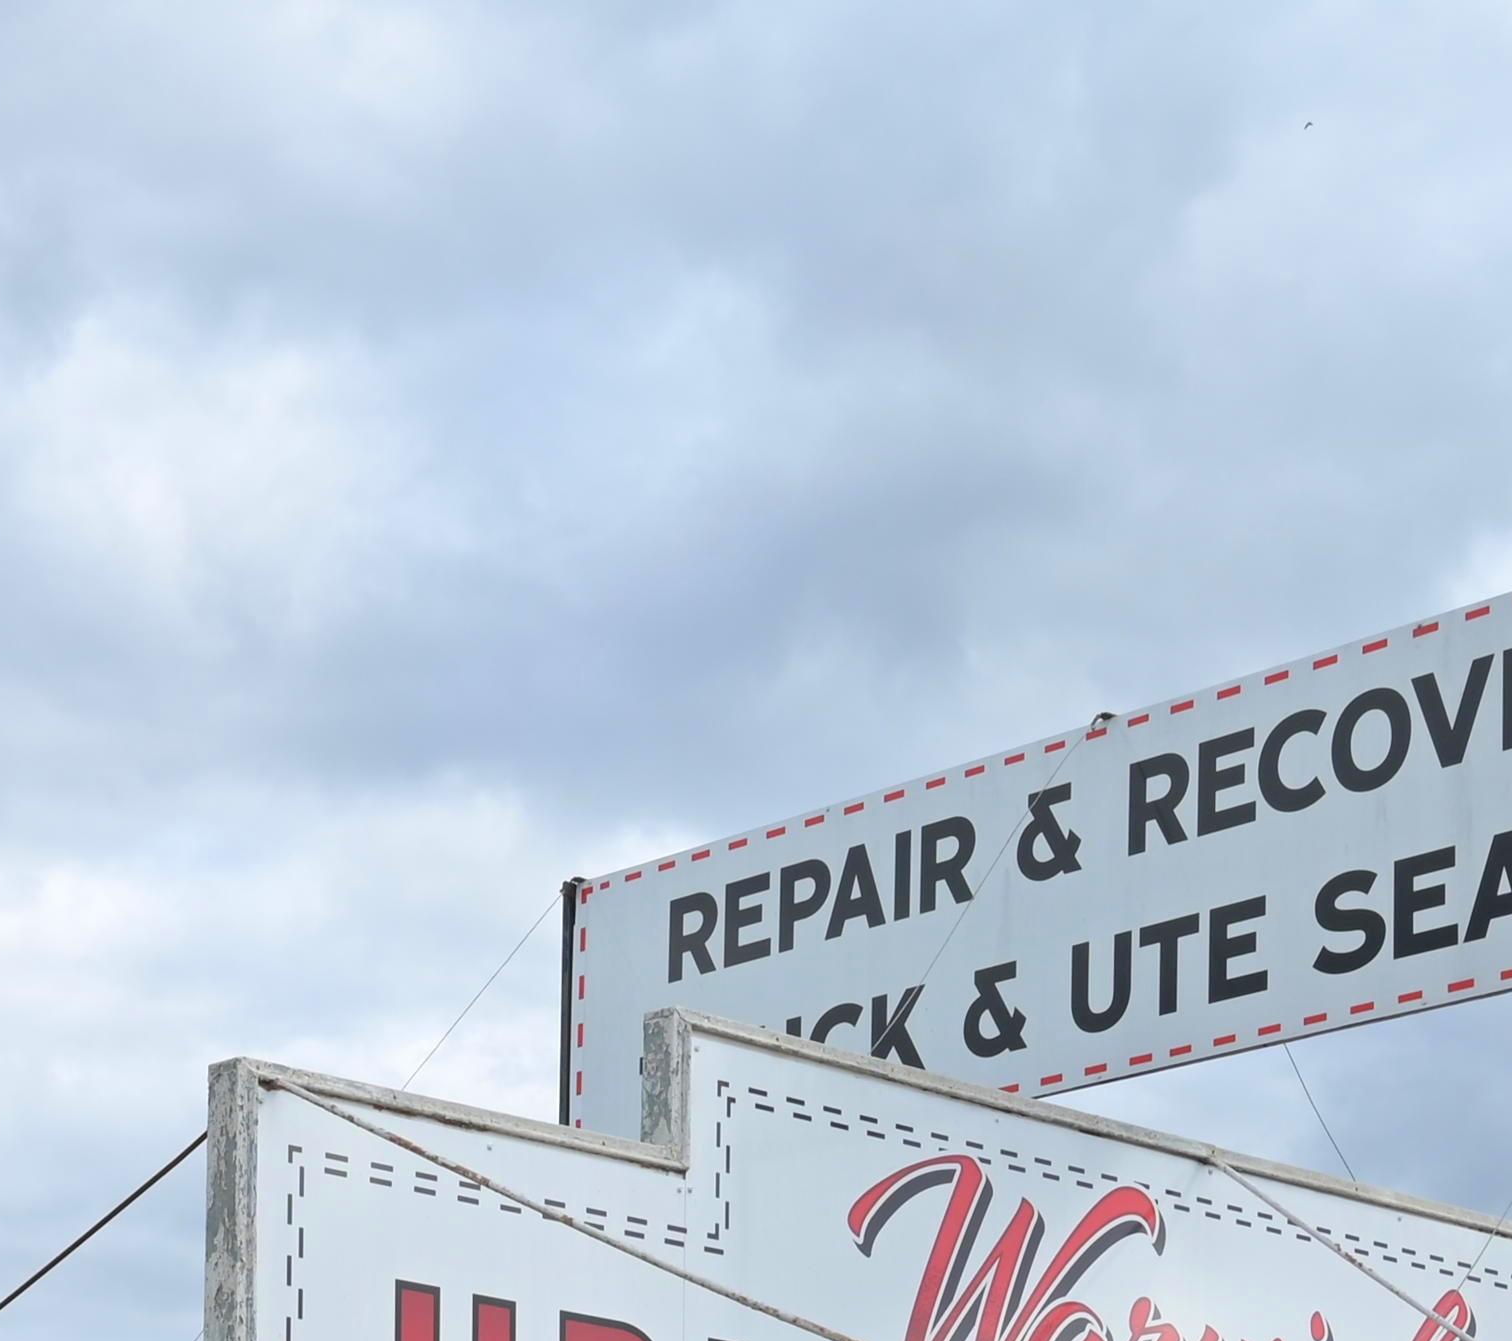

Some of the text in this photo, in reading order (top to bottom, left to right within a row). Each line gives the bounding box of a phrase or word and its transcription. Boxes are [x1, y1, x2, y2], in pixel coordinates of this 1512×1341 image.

[667, 815, 975, 984] REPAIR
[1016, 781, 1082, 882] &
[962, 960, 1027, 1059] &
[1070, 894, 1269, 1034] UTE
